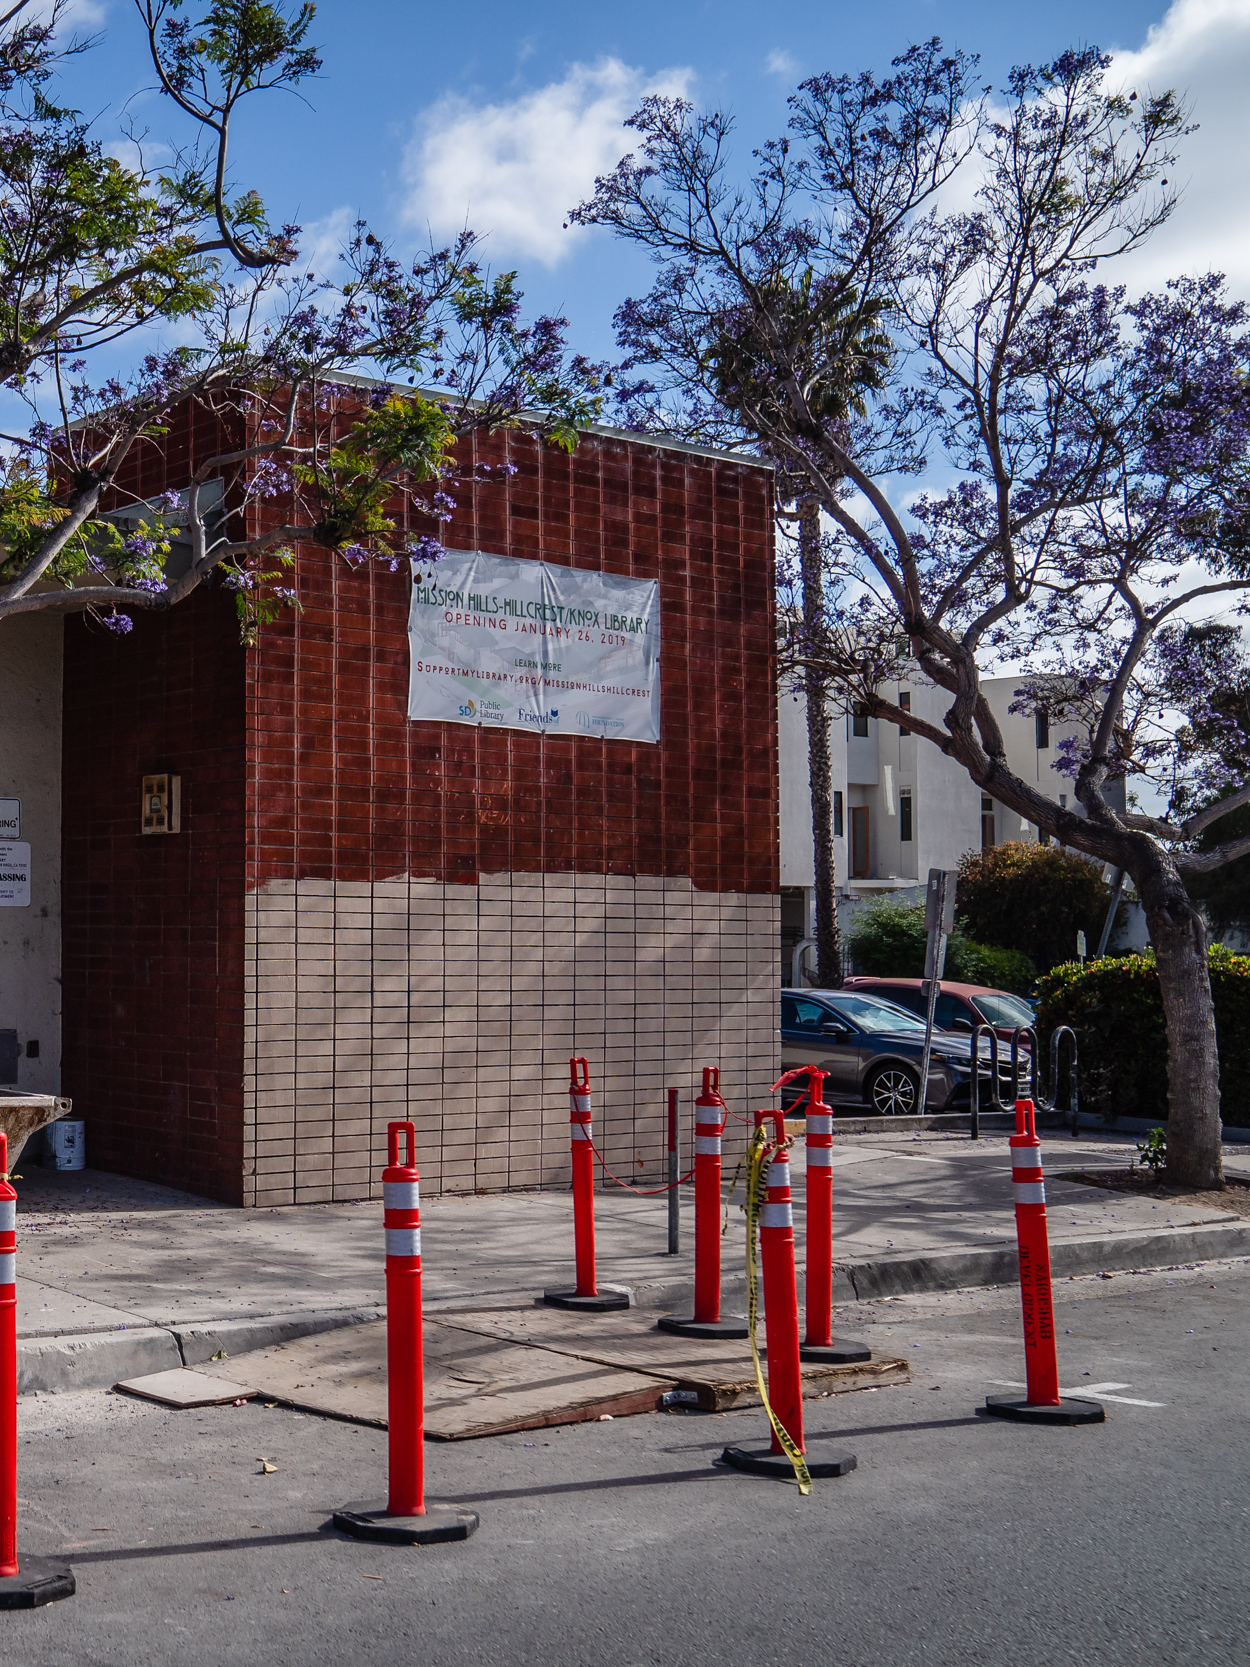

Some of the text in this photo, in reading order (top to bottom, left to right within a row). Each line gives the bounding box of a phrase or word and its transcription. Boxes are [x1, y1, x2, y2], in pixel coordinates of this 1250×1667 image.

[417, 585, 650, 635] MISSION HILLS-HILLCREST/KNOX LIBRARY
[445, 611, 507, 630] OPENING
[515, 621, 571, 640] JANUARY
[600, 633, 626, 646] 2019
[514, 658, 562, 672] LEARN MORE
[479, 700, 501, 711] Public
[479, 710, 505, 722] Library
[517, 708, 553, 724] Friends
[1019, 1246, 1037, 1349] DEVELOPMENT
